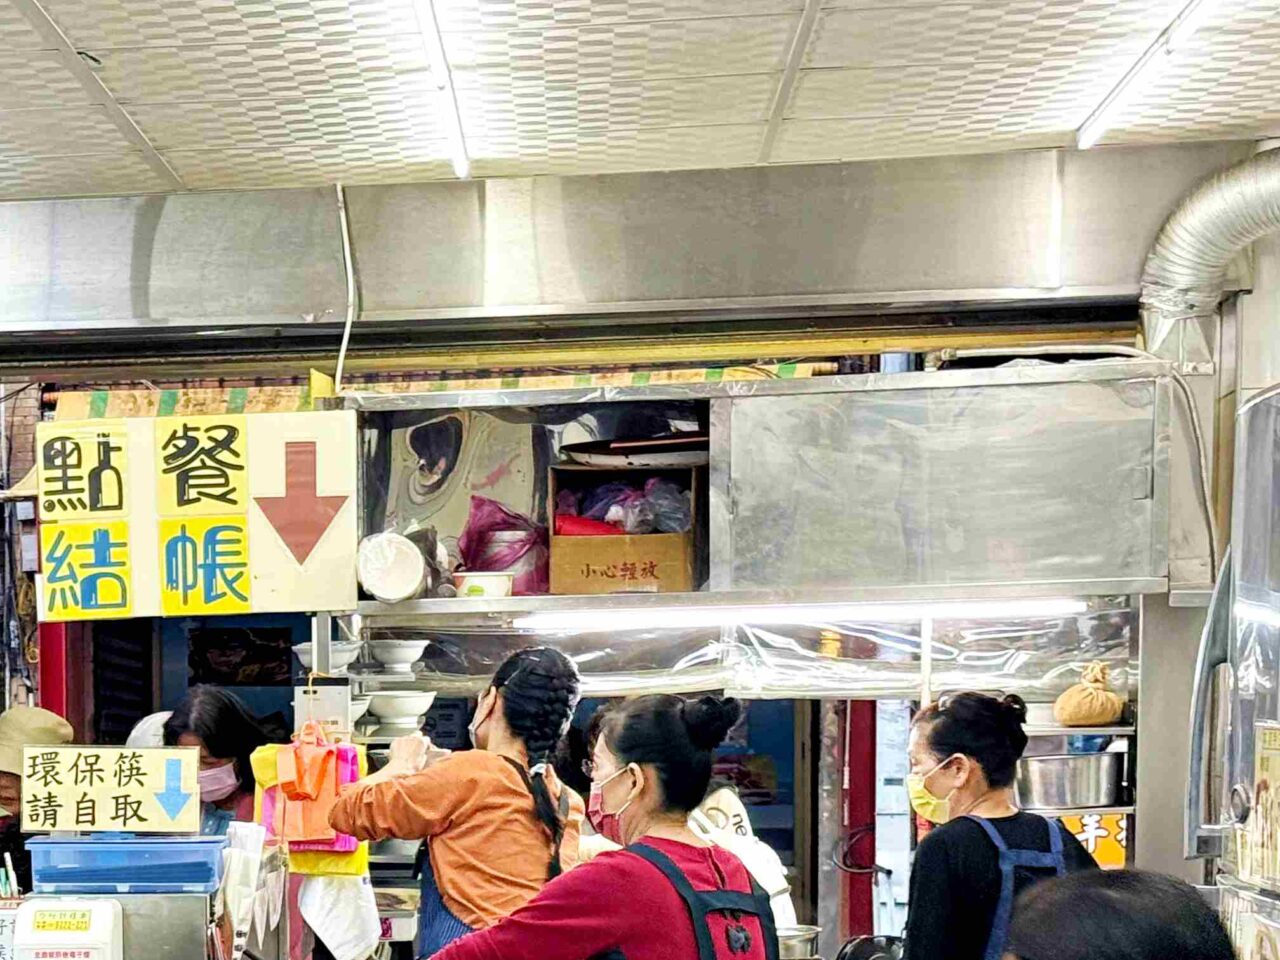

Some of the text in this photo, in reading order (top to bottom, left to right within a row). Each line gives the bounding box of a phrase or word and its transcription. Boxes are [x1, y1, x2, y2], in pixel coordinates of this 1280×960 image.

[42, 423, 245, 512] 點餐
[45, 524, 249, 613] 結帳
[581, 560, 661, 581] 小心輕放
[25, 751, 148, 788] 環保筷
[25, 791, 149, 828] 請自取
